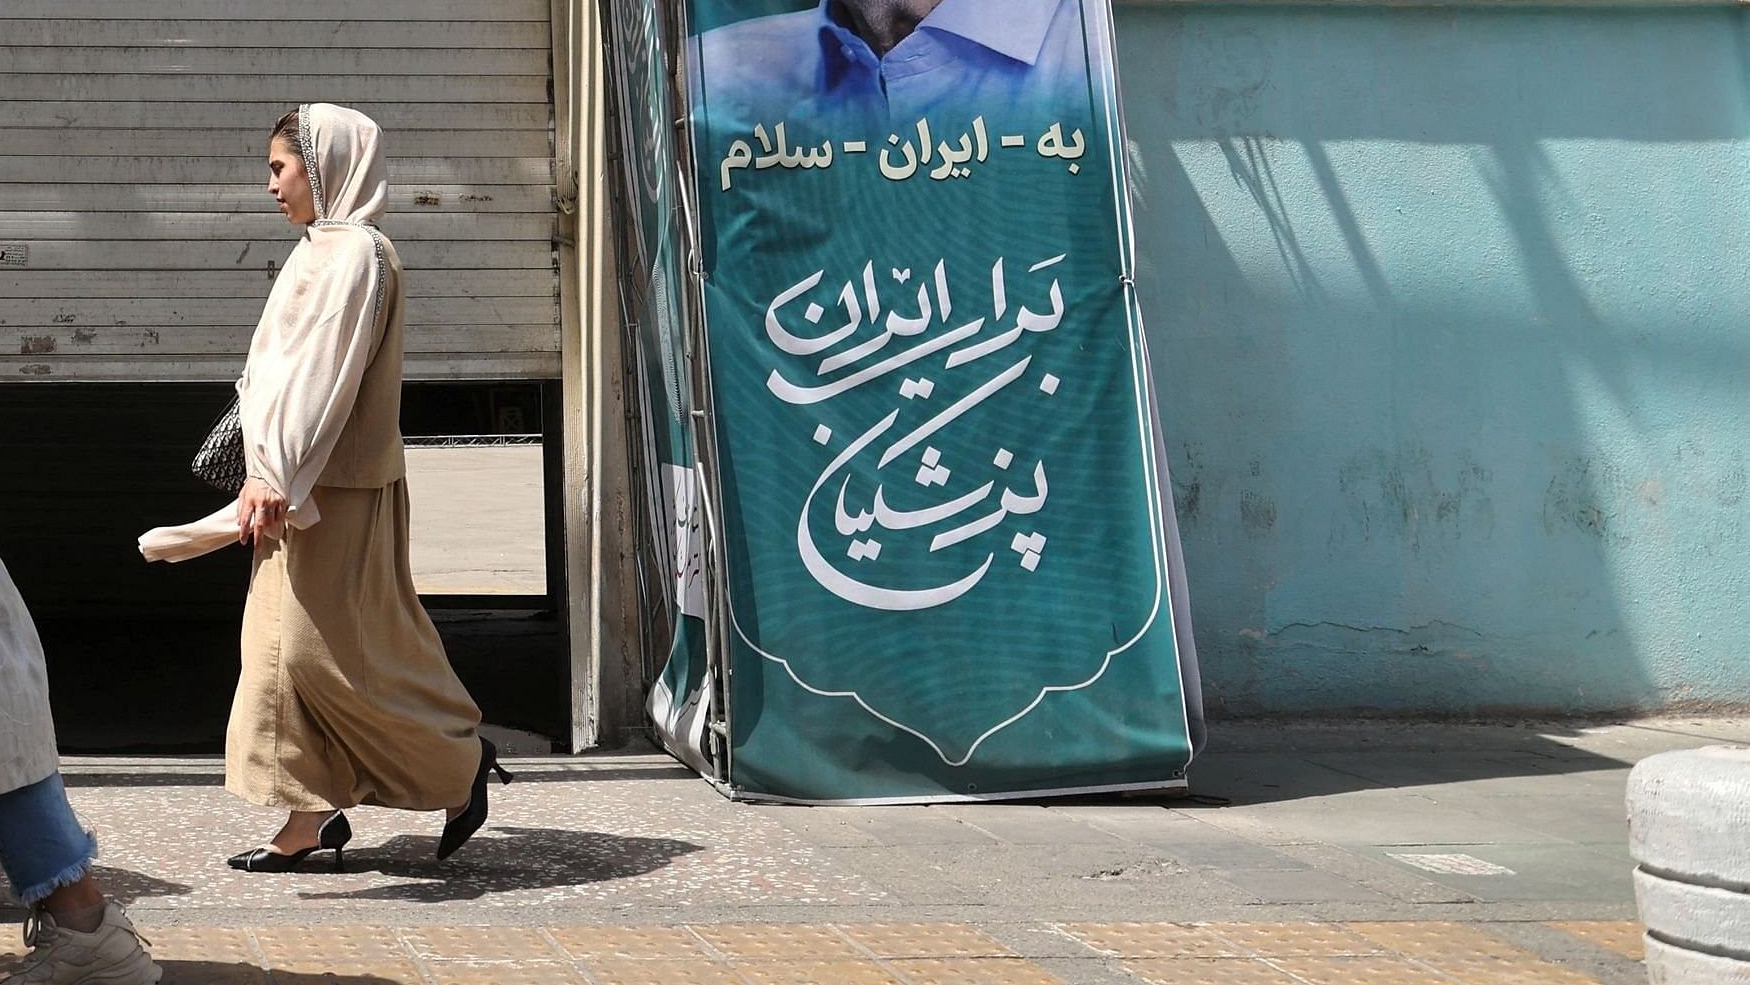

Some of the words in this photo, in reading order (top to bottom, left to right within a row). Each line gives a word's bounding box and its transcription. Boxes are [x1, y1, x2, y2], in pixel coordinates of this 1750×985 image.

[721, 122, 832, 190] سلام
[880, 116, 988, 179] ایران
[1037, 123, 1085, 174] به
[765, 258, 952, 375] ایران
[798, 355, 1048, 610] پزشکیان
